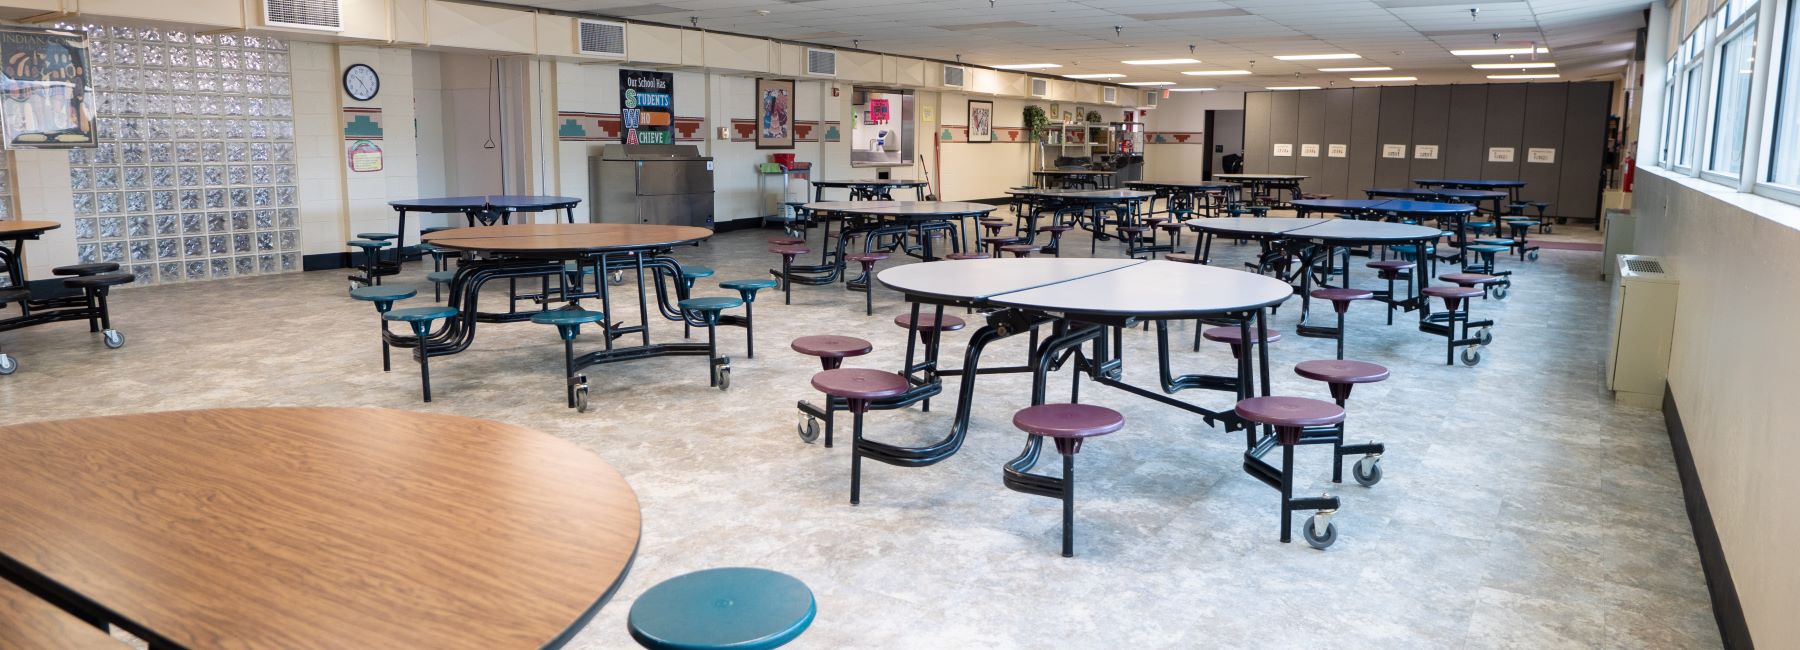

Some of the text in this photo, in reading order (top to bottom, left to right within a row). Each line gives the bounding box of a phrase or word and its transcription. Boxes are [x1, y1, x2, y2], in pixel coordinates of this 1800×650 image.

[3, 33, 46, 45] INDIAN
[639, 77, 656, 88] School
[625, 89, 669, 108] STUDENTS
[623, 109, 651, 128] WHO
[626, 129, 663, 144] ACHIEVE
